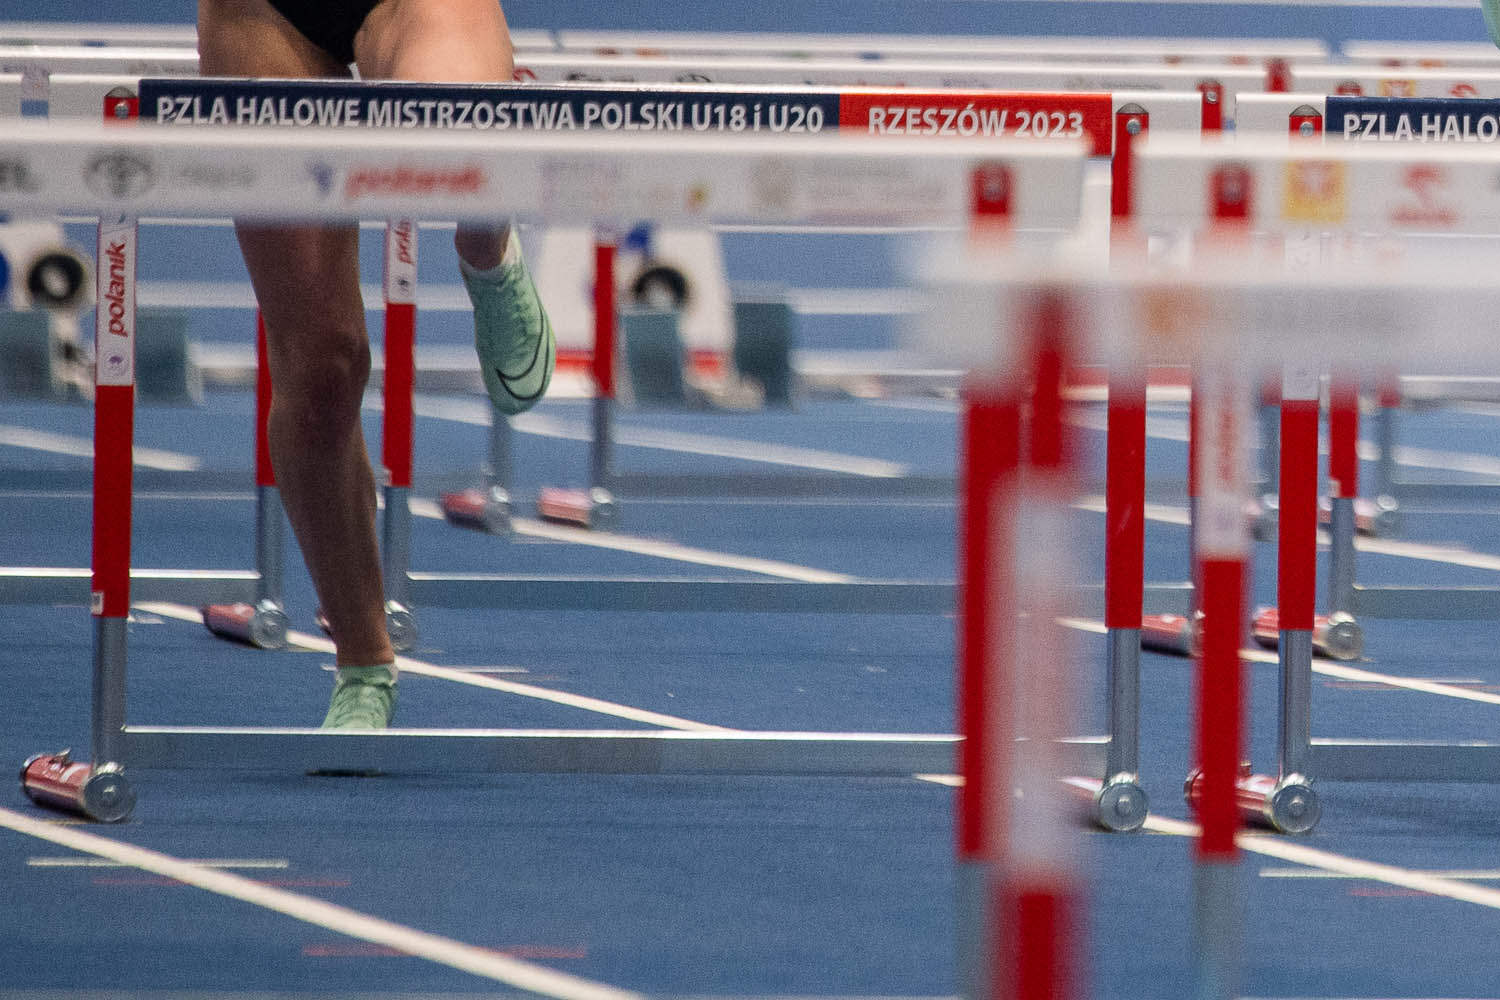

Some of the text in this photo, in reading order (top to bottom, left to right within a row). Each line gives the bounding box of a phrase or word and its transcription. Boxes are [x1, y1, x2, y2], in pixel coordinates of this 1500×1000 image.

[156, 96, 1085, 139] PZLA HALOWE MISTRZOSTWA POLSKI U18 i U20 RZESZÓW 2023
[1343, 113, 1416, 142] PZLA
[104, 241, 129, 338] polanik
